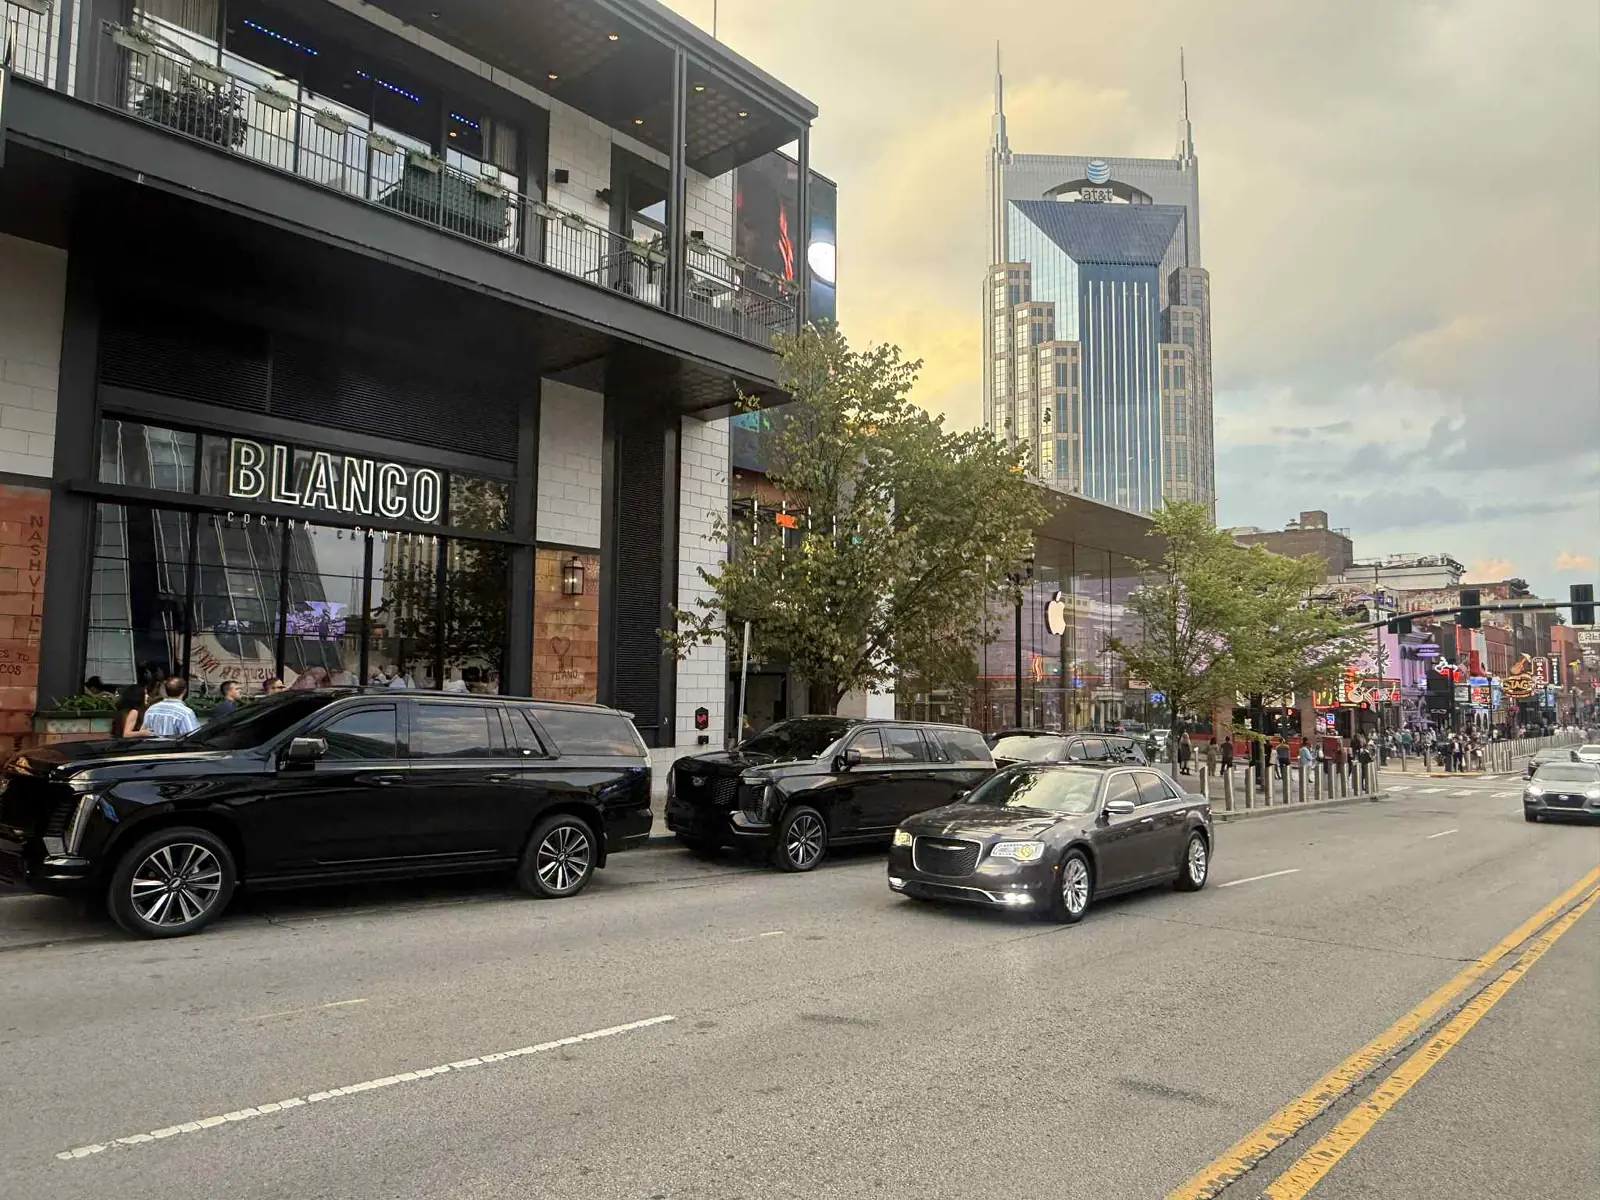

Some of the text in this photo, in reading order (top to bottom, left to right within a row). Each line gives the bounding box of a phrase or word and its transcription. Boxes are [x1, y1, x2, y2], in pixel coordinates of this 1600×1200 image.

[1083, 188, 1113, 201] at&t
[229, 437, 441, 522] BLANCO
[227, 511, 438, 545] COCINA CANTINA
[27, 515, 44, 648] NASHVILLE
[16, 652, 30, 661] TO
